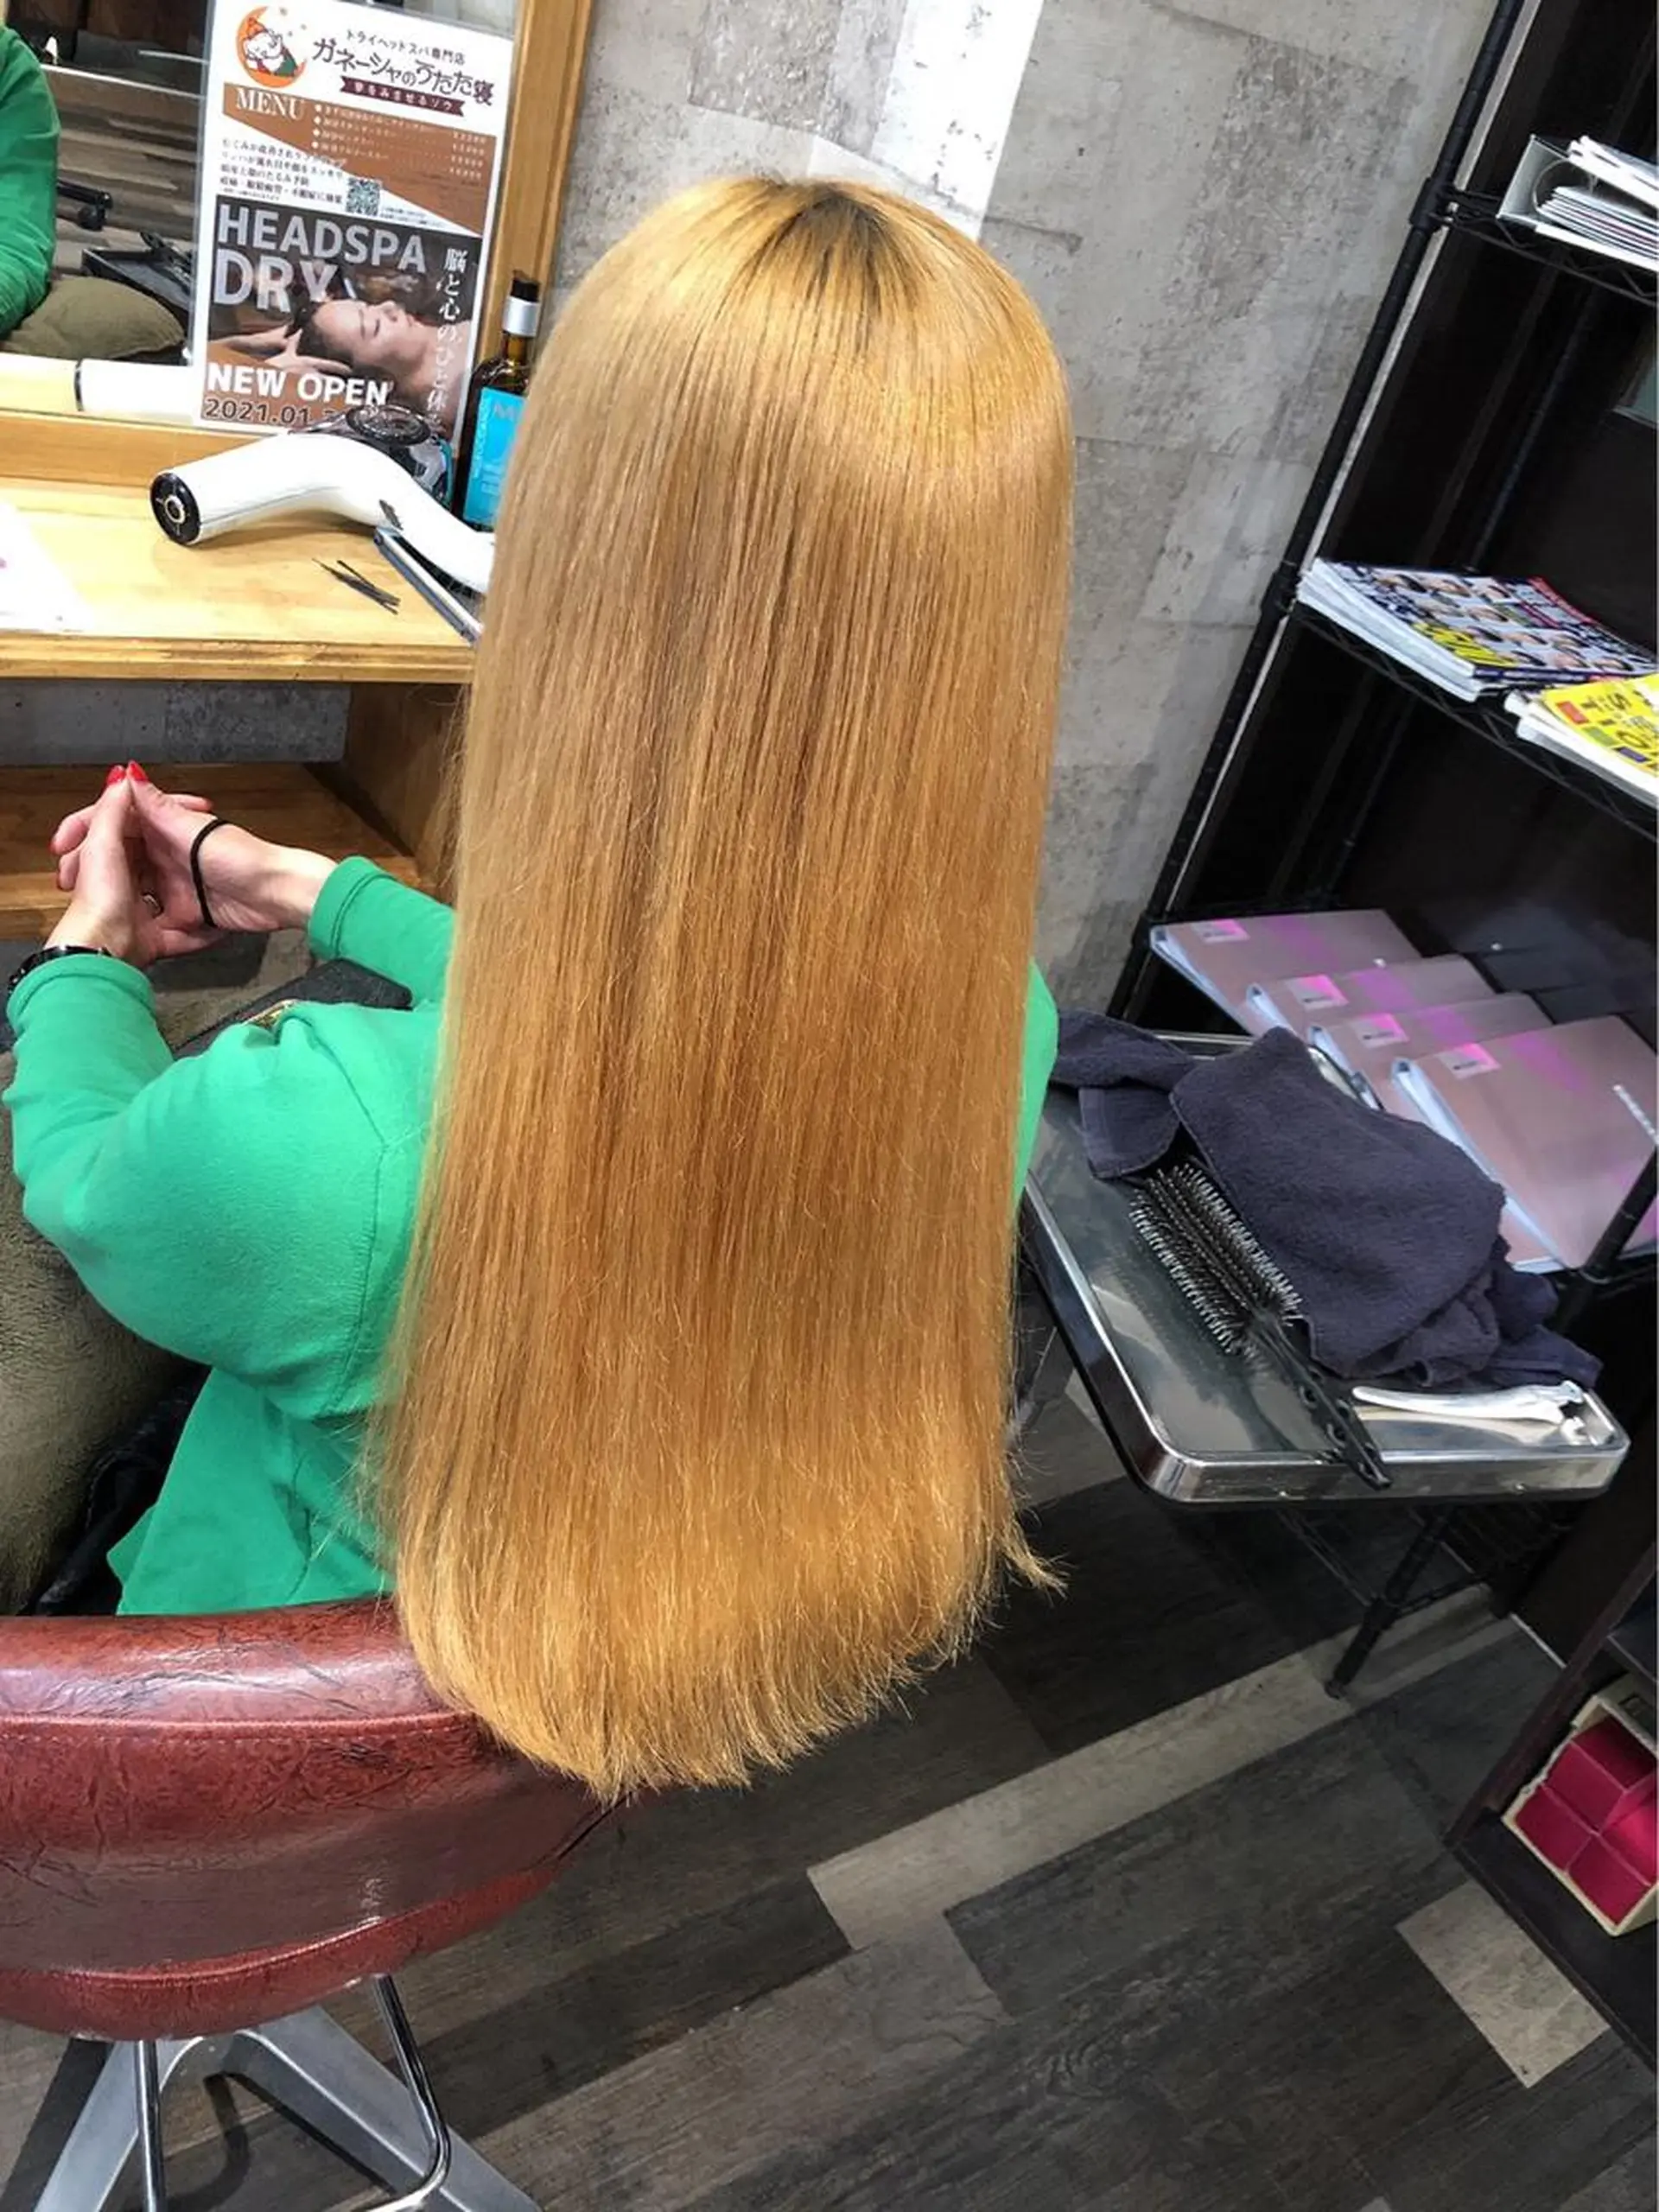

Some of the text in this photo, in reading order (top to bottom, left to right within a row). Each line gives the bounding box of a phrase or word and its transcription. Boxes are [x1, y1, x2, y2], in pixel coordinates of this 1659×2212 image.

[236, 87, 305, 120] MENU
[312, 37, 495, 105] ガネーシャのうたた寝
[218, 203, 426, 274] HEADSPA
[213, 247, 338, 314] DRY
[207, 363, 391, 405] NEW OPEN
